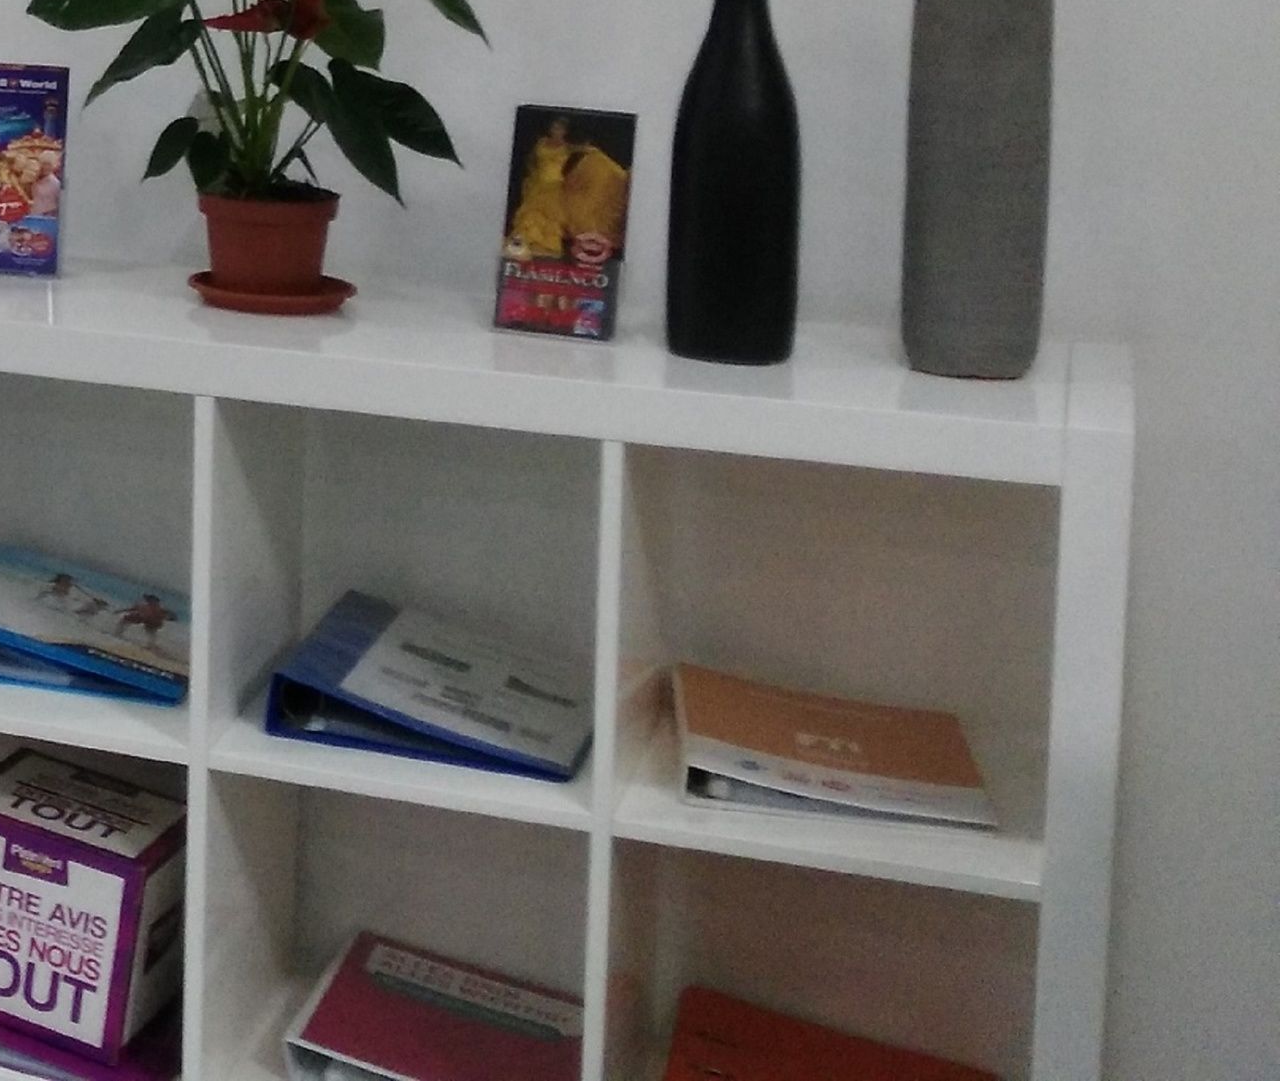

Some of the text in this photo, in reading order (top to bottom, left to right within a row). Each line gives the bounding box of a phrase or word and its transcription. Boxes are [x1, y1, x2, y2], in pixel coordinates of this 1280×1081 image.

[11, 792, 129, 838] TOUT
[49, 903, 108, 940] AVIS
[29, 936, 101, 981] NOUS
